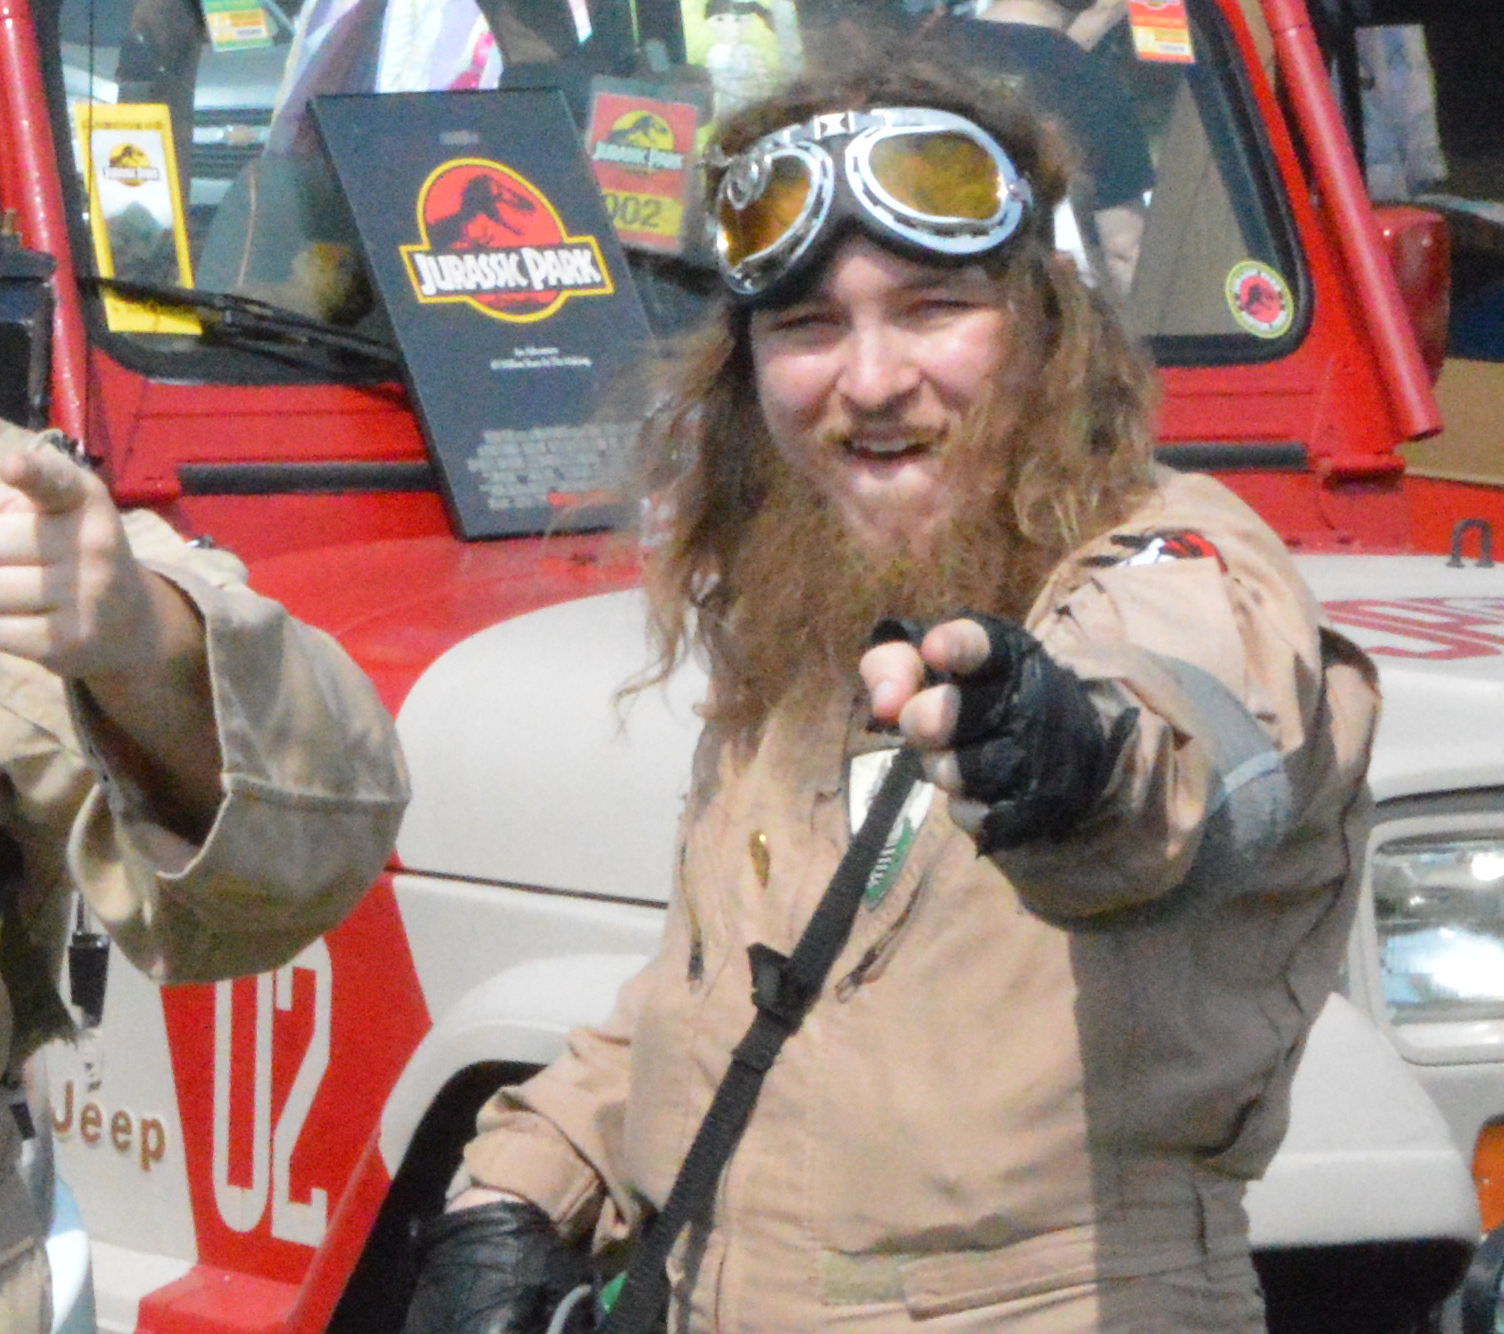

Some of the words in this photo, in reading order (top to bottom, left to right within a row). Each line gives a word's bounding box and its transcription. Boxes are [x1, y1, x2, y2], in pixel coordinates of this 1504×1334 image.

[413, 251, 529, 296] JURASSIC
[520, 246, 603, 291] PARK
[50, 1079, 168, 1172] Jeep
